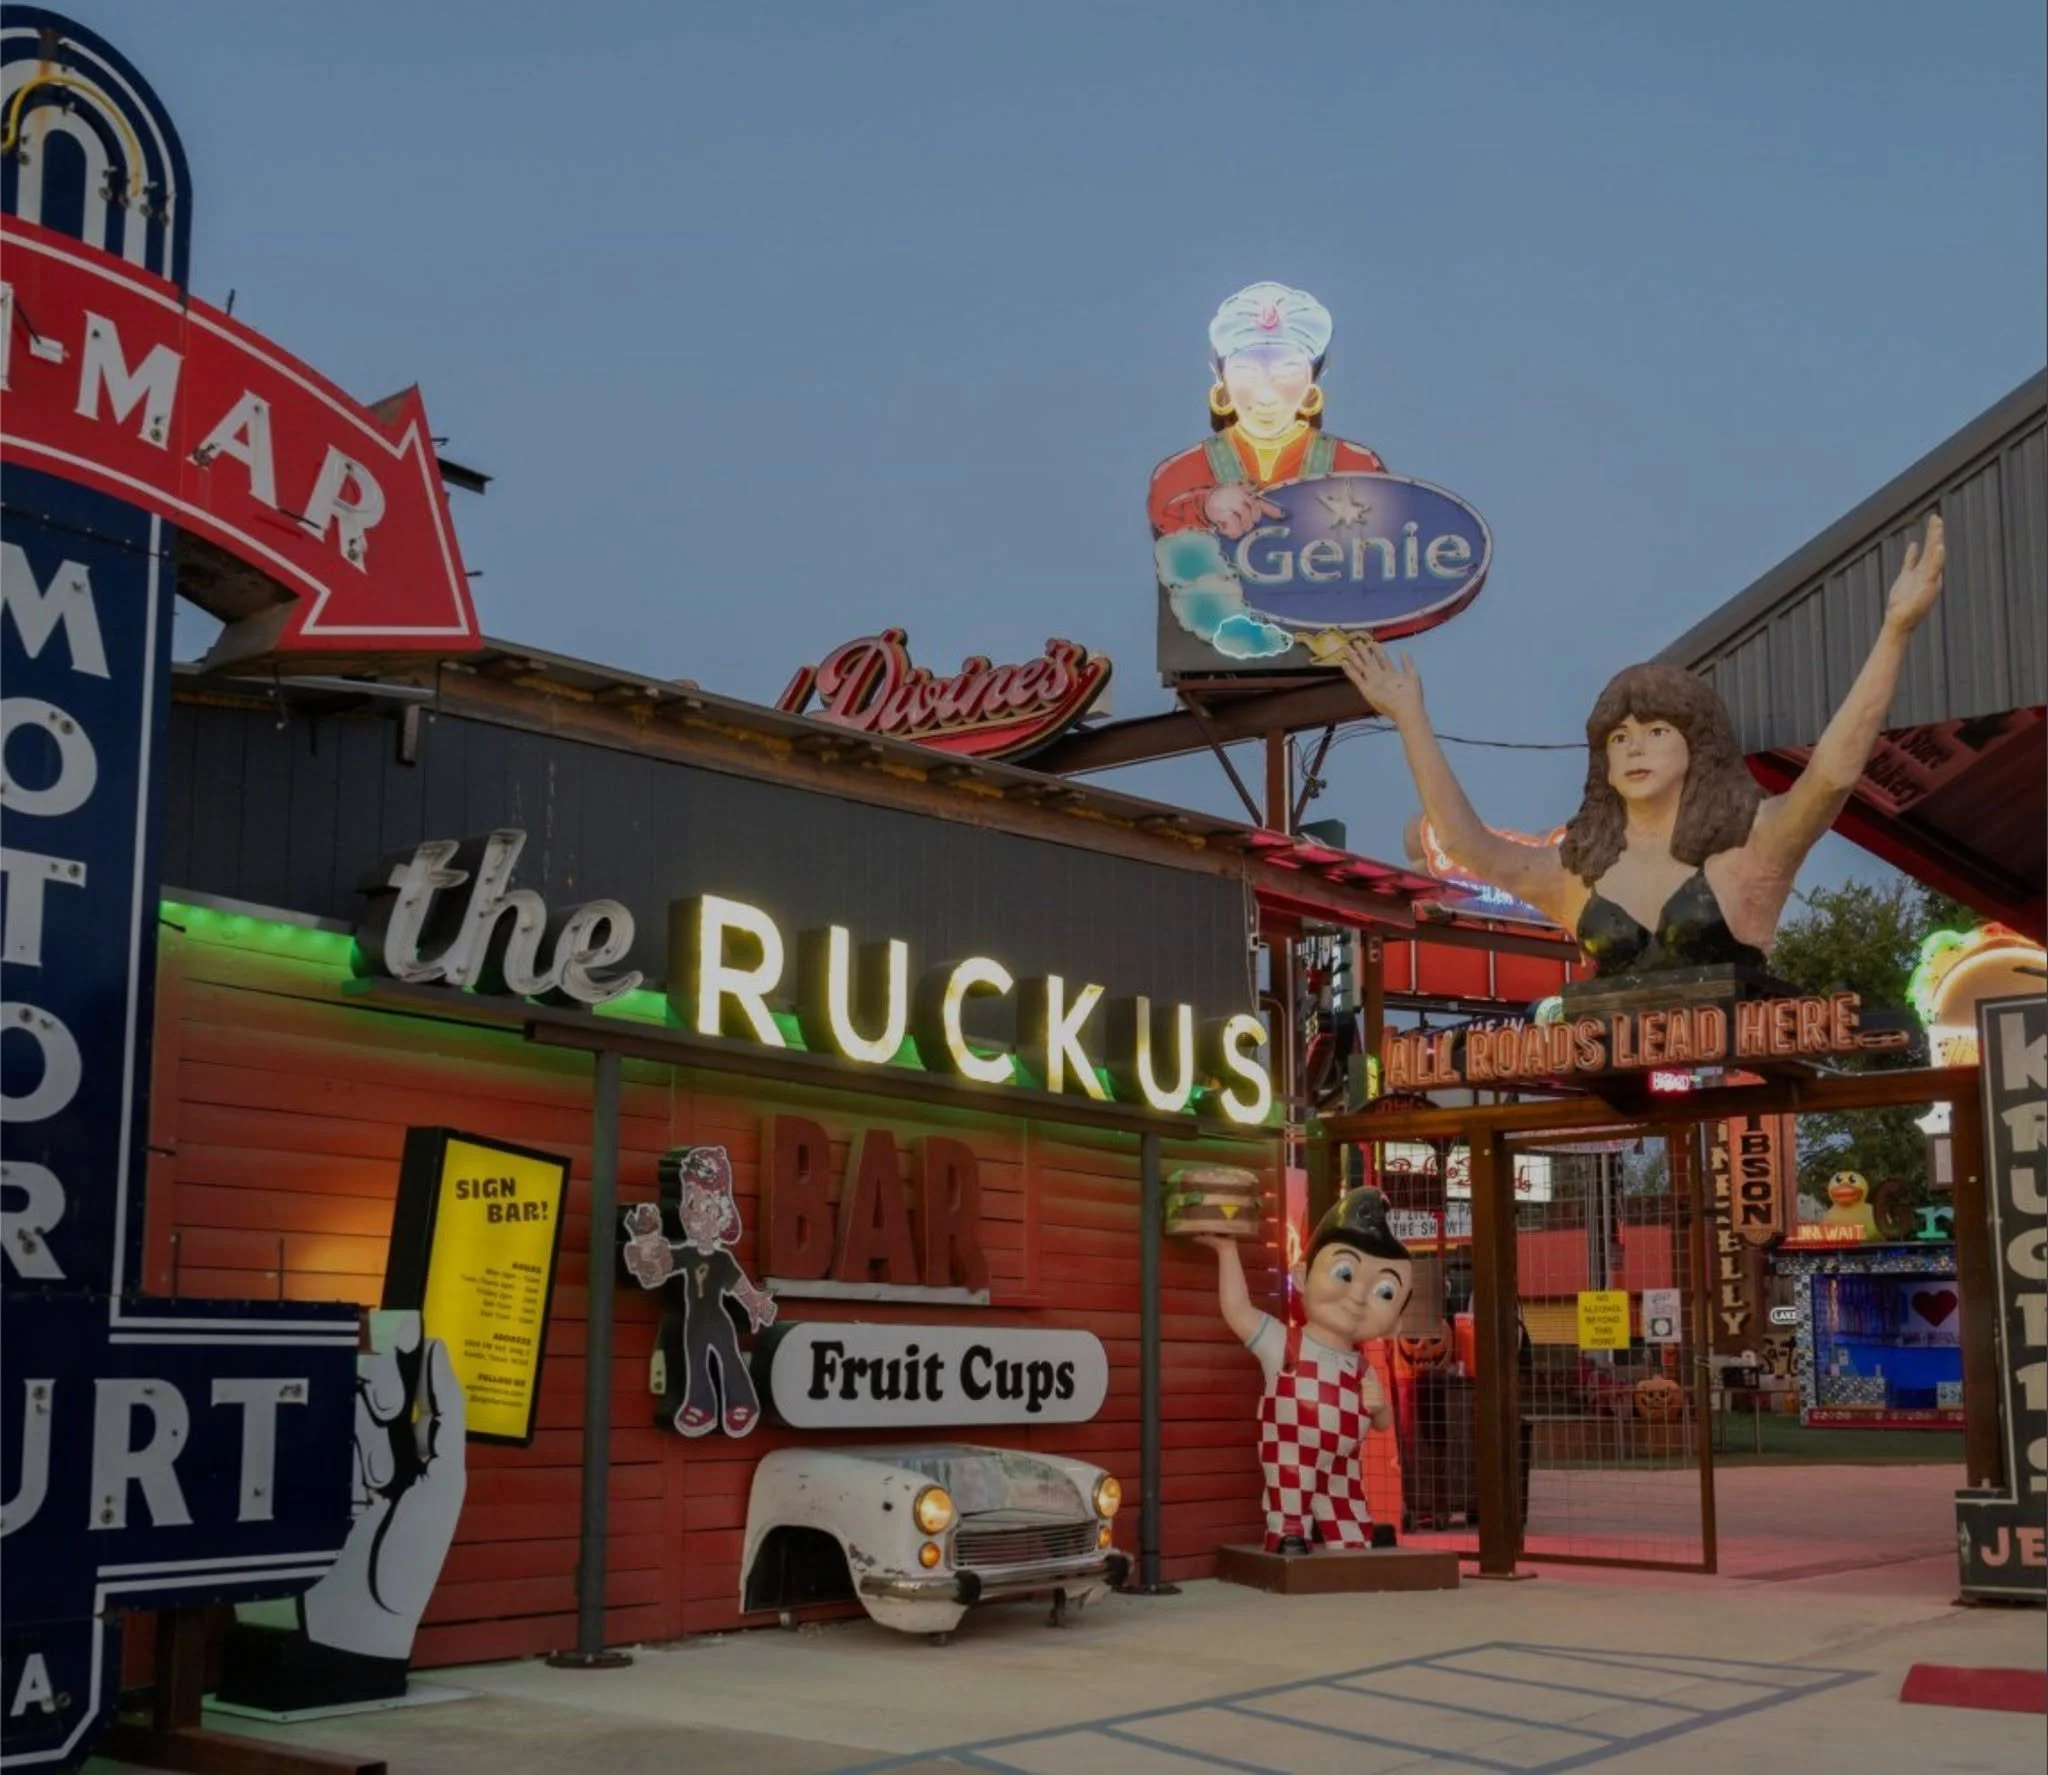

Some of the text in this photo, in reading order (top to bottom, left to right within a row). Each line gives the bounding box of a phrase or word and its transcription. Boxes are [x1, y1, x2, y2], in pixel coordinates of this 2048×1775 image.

[1234, 521, 1478, 584] Genie
[0, 540, 112, 1280] MOTOR
[385, 828, 1274, 1125] the RUCKUS
[1381, 990, 1863, 1089] ALL ROADS LEAD HERE
[455, 1177, 517, 1200] SIGN
[486, 1200, 550, 1224] BAR!
[762, 1112, 991, 1293] BAR
[807, 1340, 1076, 1413] Fruit Cups
